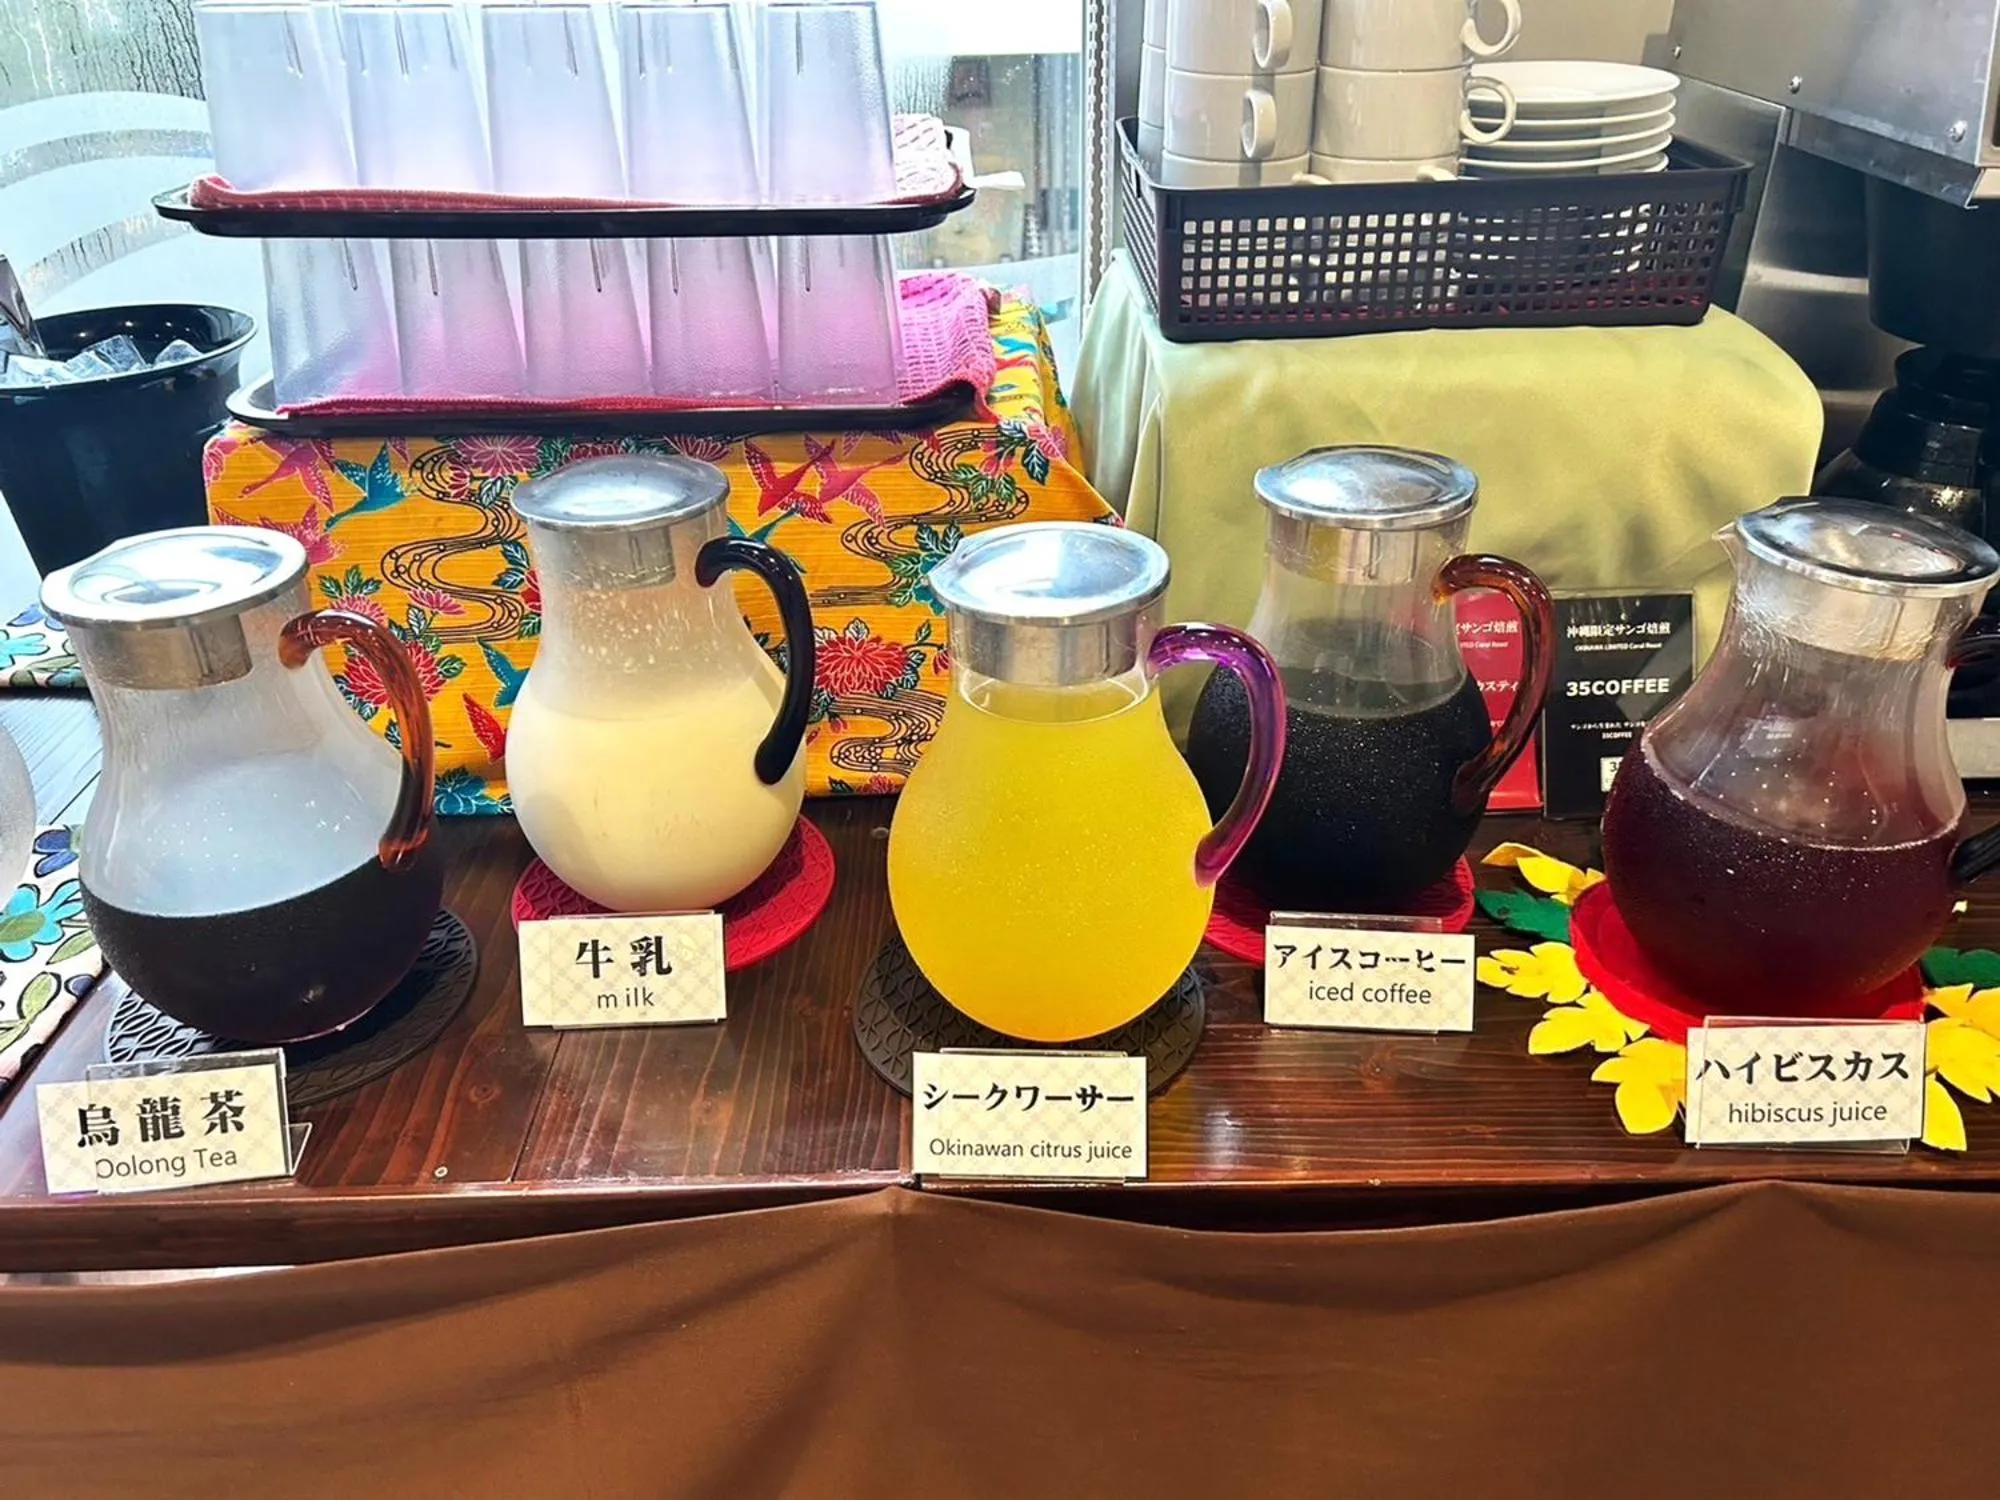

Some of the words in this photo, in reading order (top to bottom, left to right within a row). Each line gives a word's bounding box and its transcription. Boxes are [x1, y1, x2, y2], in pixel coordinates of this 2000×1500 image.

[1566, 621, 1671, 638] 沖縄限定サンゴ焙煎
[1566, 678, 1670, 697] 35COFFEE
[576, 936, 672, 979] 牛乳
[1274, 944, 1466, 973] アイスコーヒー
[1308, 980, 1354, 1002] iced
[1362, 983, 1432, 1004] coffee
[1695, 1051, 1909, 1085] ハイビスカス
[923, 1083, 1134, 1112] シークワーサー
[77, 1090, 245, 1148] 烏龍茶
[1728, 1102, 1824, 1123] hibiscus
[1829, 1101, 1888, 1128] juice
[95, 1154, 187, 1179] Oolong
[193, 1147, 238, 1170] Tea
[929, 1138, 1024, 1157] Okinawan
[1030, 1140, 1082, 1158] citrus
[1086, 1140, 1133, 1163] juice
